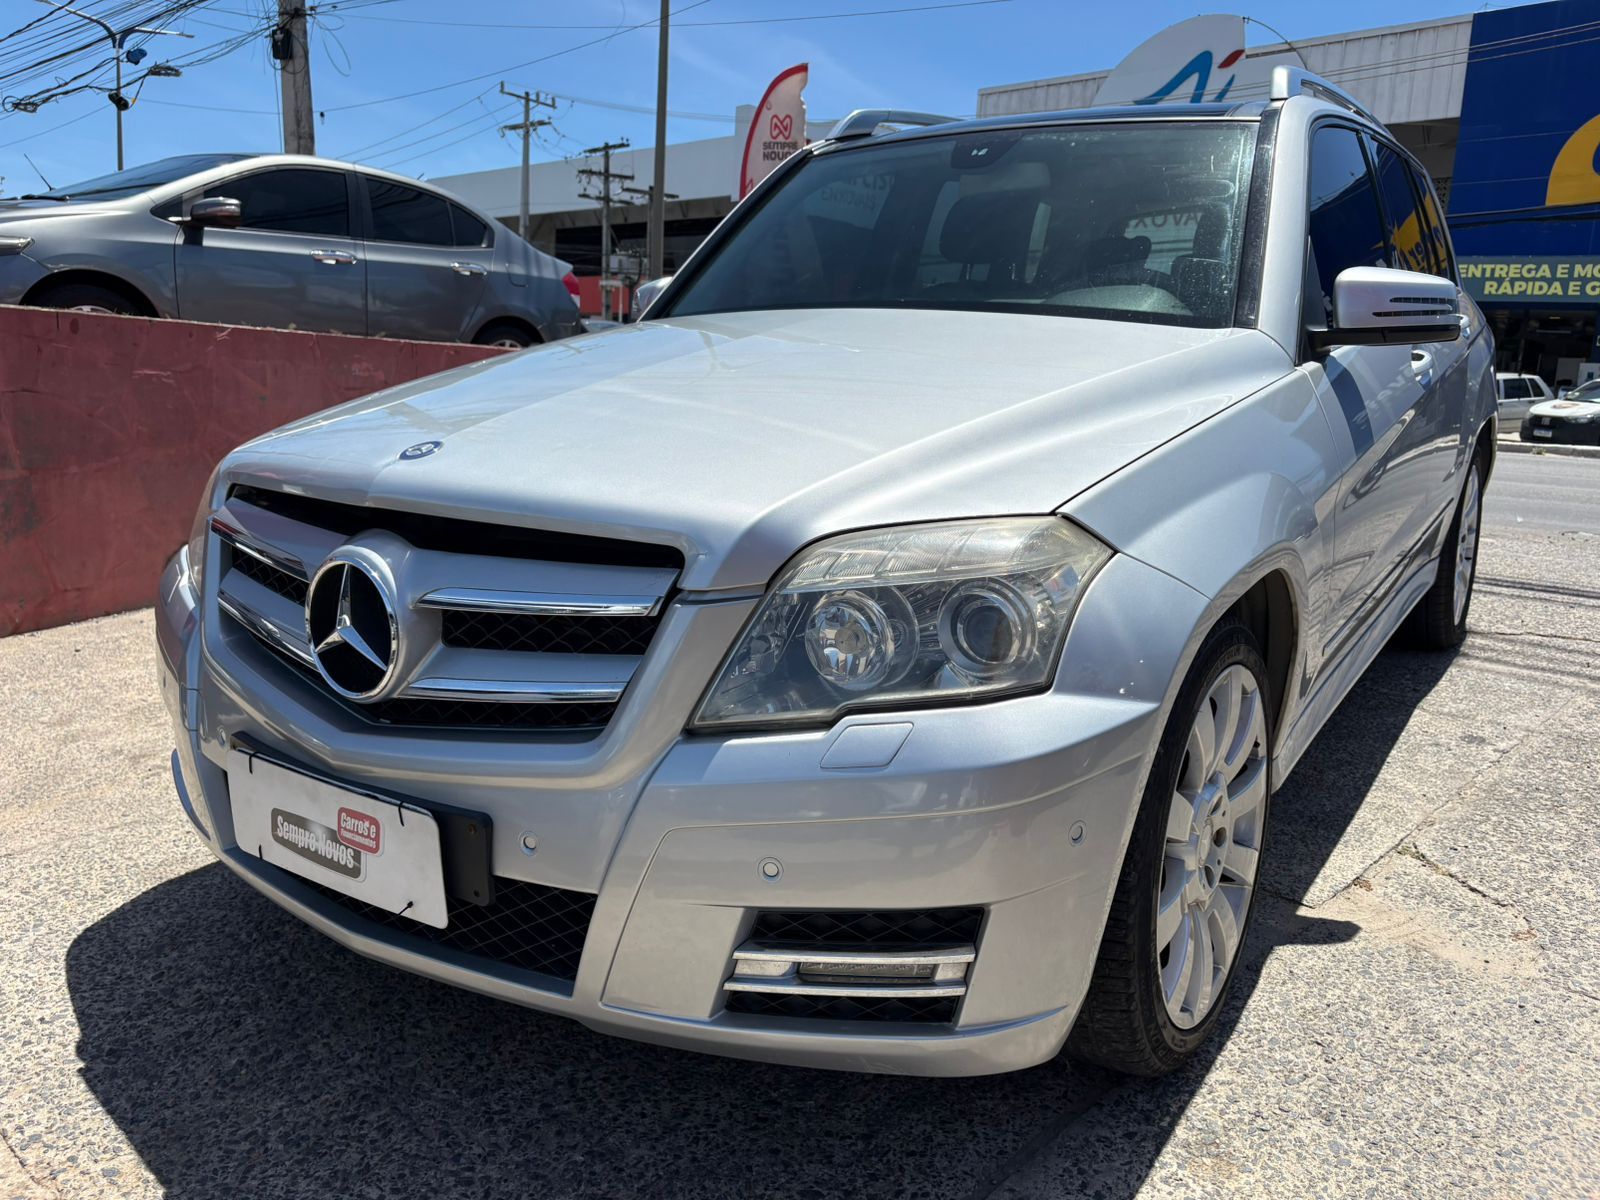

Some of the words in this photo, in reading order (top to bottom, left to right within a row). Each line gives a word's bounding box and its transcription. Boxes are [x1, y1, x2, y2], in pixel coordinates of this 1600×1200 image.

[1458, 263, 1552, 278] ENTREGA
[1556, 263, 1570, 278] E
[1483, 277, 1563, 296] RÁPIDA
[1567, 281, 1582, 296] E
[318, 832, 354, 869] Novos
